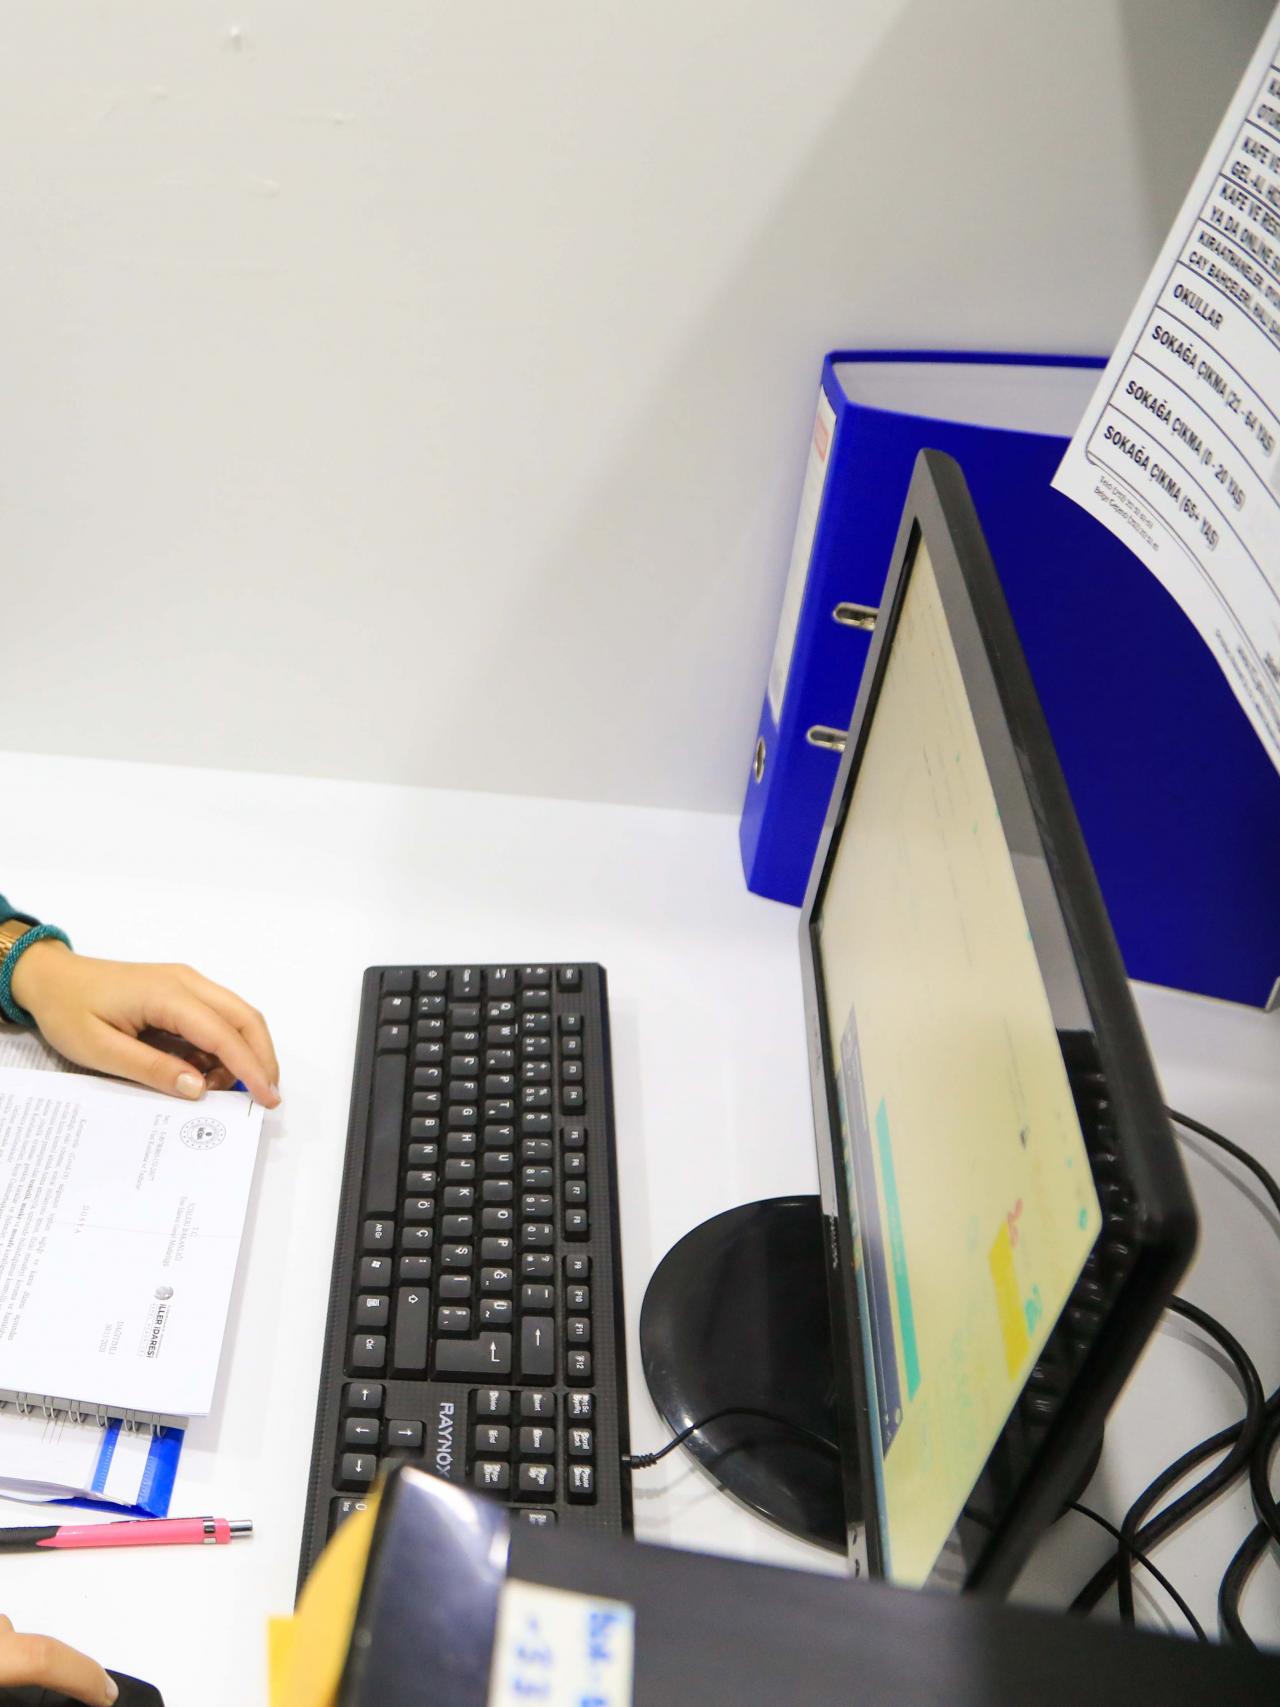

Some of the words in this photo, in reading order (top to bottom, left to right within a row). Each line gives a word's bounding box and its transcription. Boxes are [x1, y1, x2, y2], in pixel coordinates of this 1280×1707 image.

[1220, 182, 1248, 211] KAFE
[1249, 202, 1262, 222] VE
[1210, 205, 1224, 226] YA
[1224, 215, 1240, 237] DA
[1173, 284, 1223, 330] OKULLAR
[1152, 325, 1196, 370] SOKAĞA
[1196, 361, 1228, 397] ÇIKMA
[1125, 380, 1171, 425] SOKAĞA
[1171, 417, 1202, 458] ÇIKMA
[1214, 468, 1228, 487] 20
[1103, 425, 1149, 471] SOKAĞA
[1149, 461, 1181, 503] ÇIKMA
[1178, 494, 1200, 528] (65+
[1198, 515, 1220, 553] YAŞ)
[500, 1002, 510, 1010] Q
[464, 1032, 474, 1040] S
[500, 1026, 510, 1035] W
[461, 1133, 471, 1141] H
[498, 1153, 509, 1161] U
[571, 1158, 579, 1166] F6
[458, 1188, 469, 1196] K
[572, 1186, 580, 1194] F7
[416, 1200, 430, 1208] Ö
[497, 1210, 508, 1218] O
[572, 1215, 580, 1223] F8
[416, 1229, 428, 1237] Ç
[497, 1239, 508, 1247] P
[573, 1261, 581, 1269] F9
[493, 1269, 507, 1279] Ğ
[573, 1289, 583, 1302] F10
[574, 1323, 583, 1334] F11
[574, 1355, 584, 1369] F12
[487, 1390, 498, 1410] Delete
[532, 1393, 541, 1411] Insert
[487, 1429, 497, 1443] End
[532, 1428, 542, 1448] Home
[580, 1431, 589, 1449] Scroll
[483, 1464, 493, 1482] Down
[491, 1464, 500, 1481] Page
[537, 1468, 547, 1484] Page
[581, 1467, 589, 1487] Pause
[355, 1503, 367, 1511] 0
